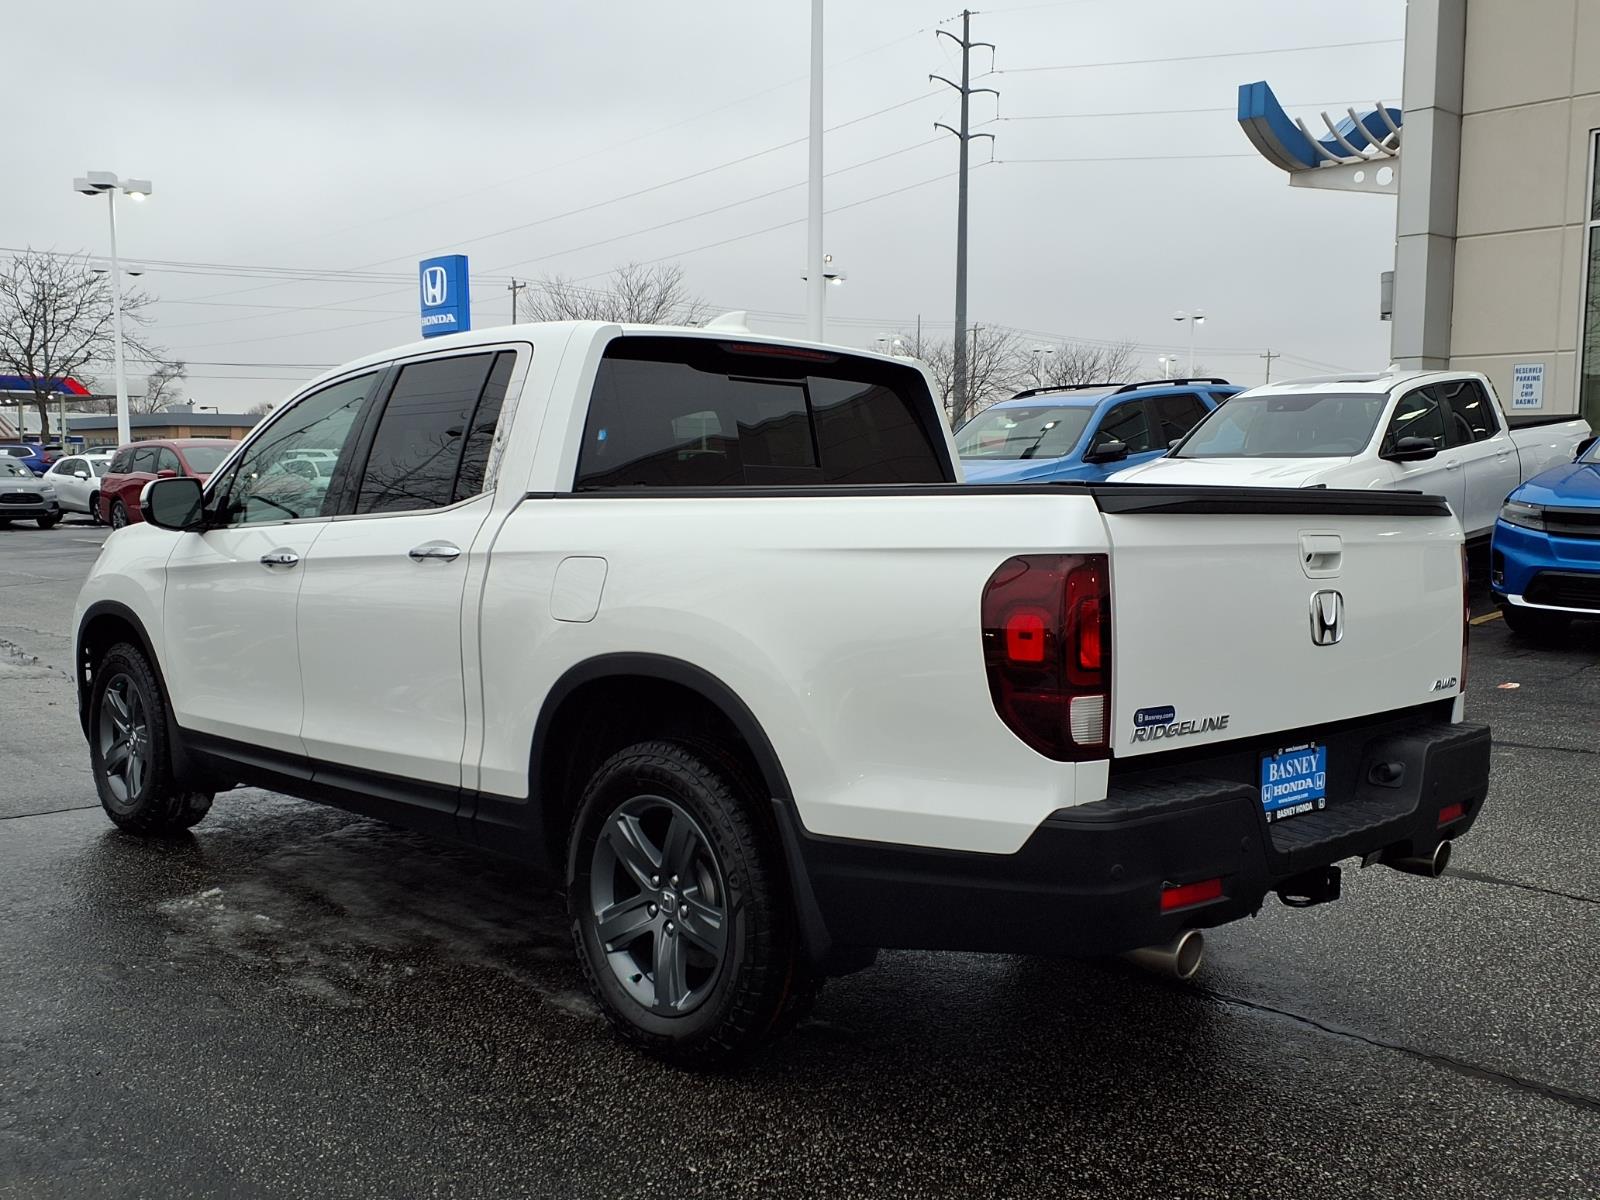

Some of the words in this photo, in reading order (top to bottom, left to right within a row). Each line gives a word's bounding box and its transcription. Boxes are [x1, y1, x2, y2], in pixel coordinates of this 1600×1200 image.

[1430, 677, 1457, 691] AWD
[1144, 712, 1174, 721] Basney.com
[1130, 715, 1230, 743] RIDGELINE
[1269, 753, 1320, 782] BASNEY
[1273, 777, 1314, 797] HONDA
[1276, 804, 1296, 819] BASNEY
[1296, 801, 1313, 815] HONDA
